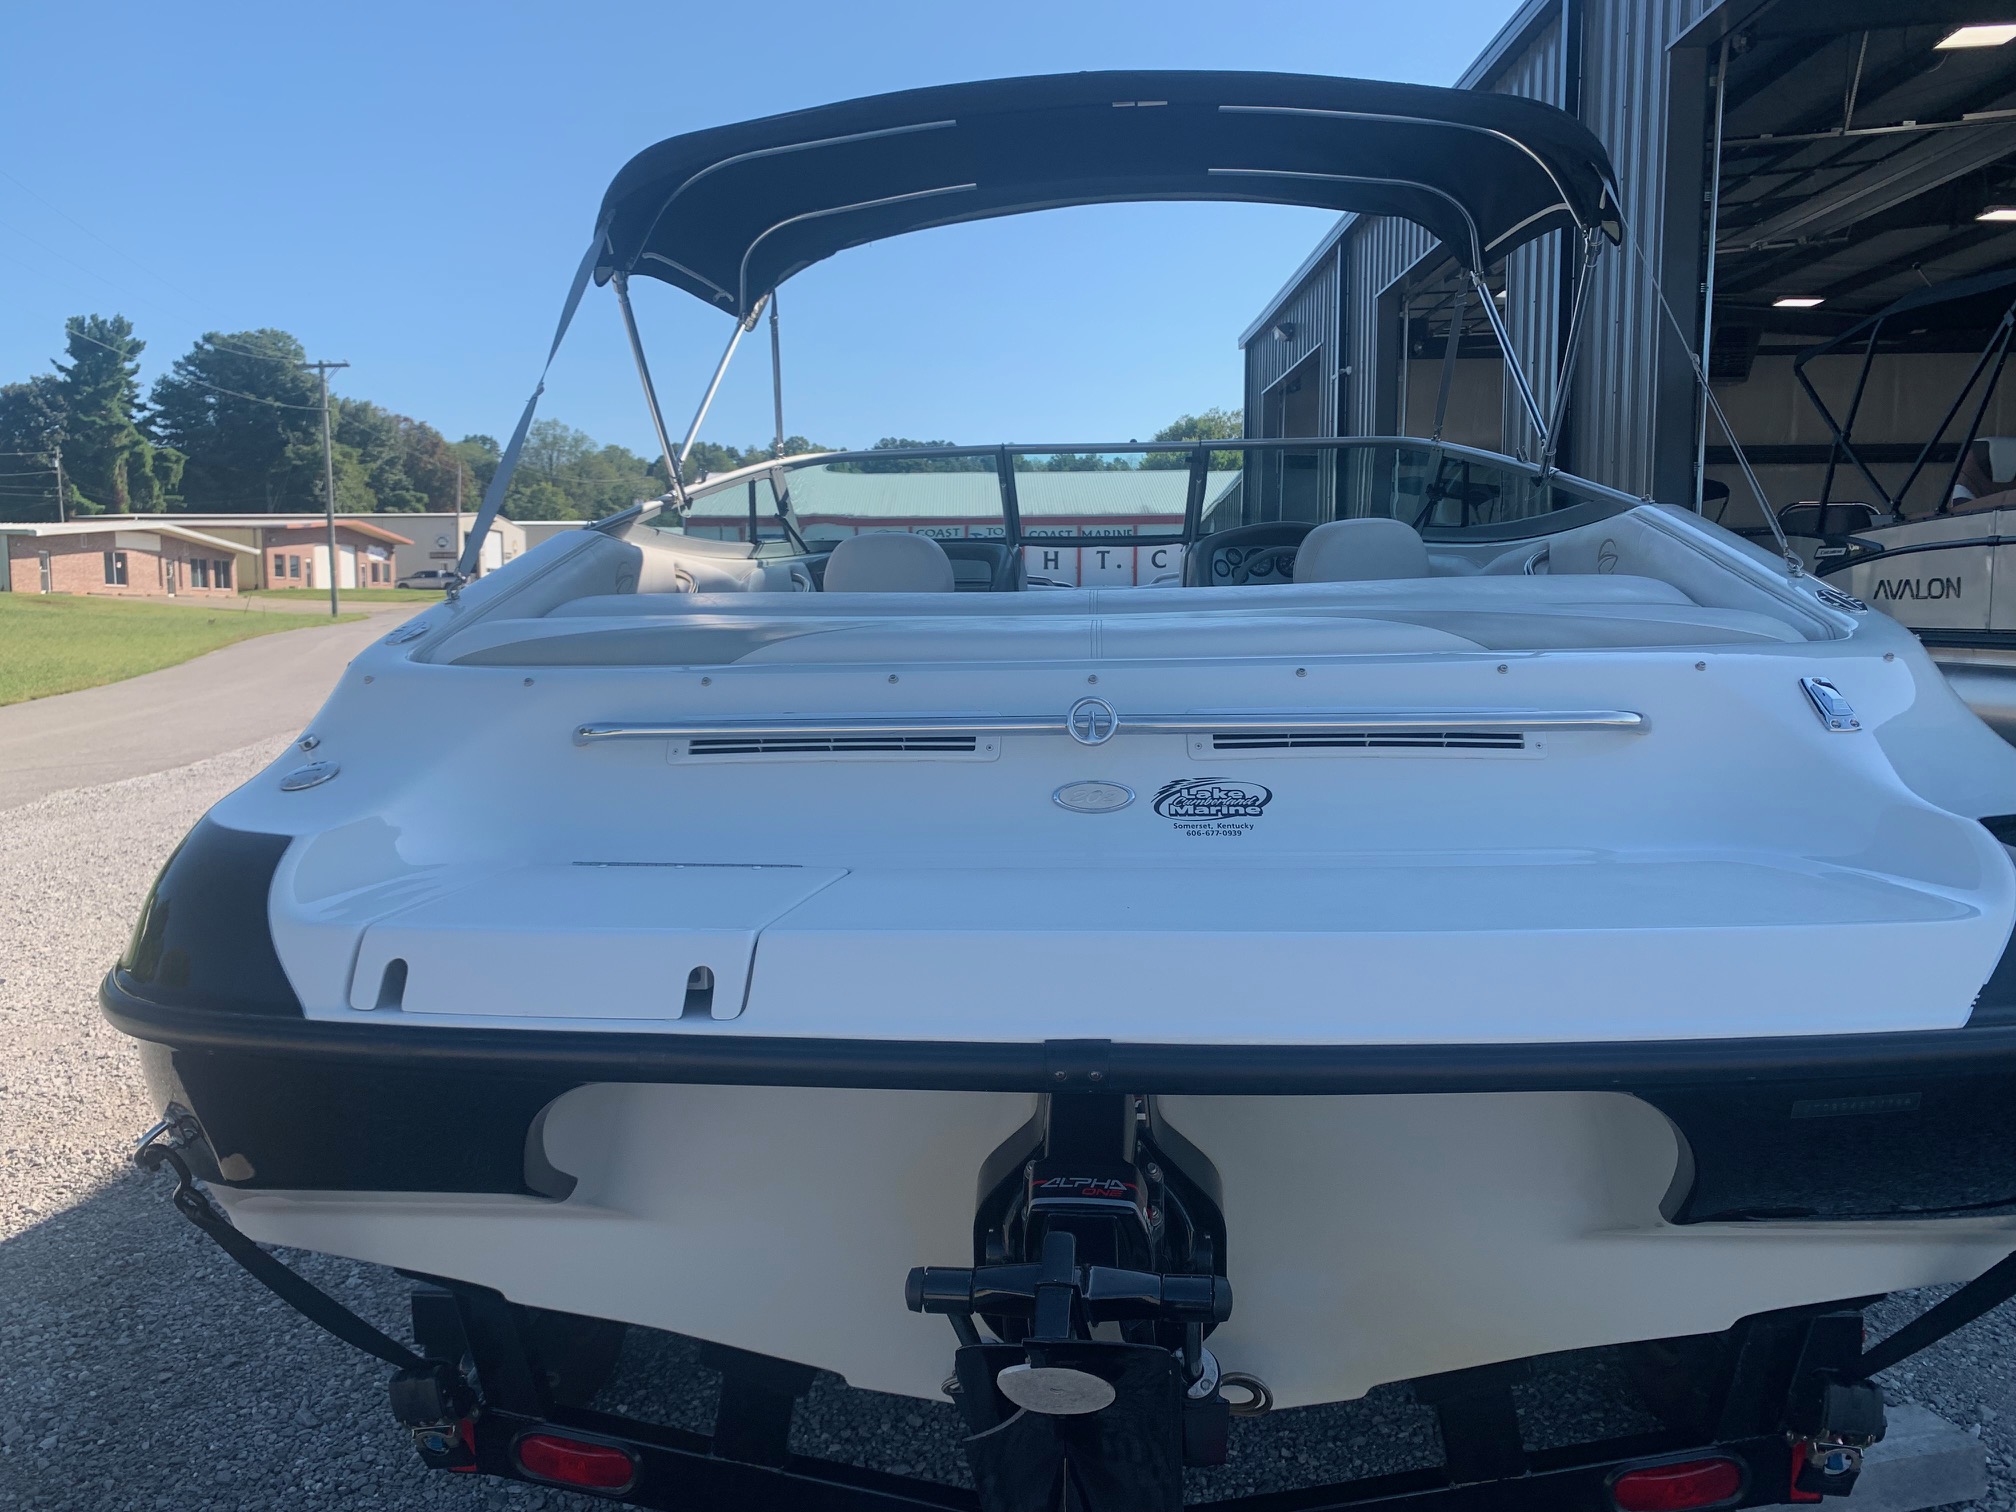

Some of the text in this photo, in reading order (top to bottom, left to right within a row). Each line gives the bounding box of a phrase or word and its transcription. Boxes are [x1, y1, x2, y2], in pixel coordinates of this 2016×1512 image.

[916, 527, 961, 538] COAST
[986, 527, 1004, 537] TO
[1043, 550, 1060, 570] H
[1151, 549, 1168, 569] C
[1872, 576, 1962, 600] AVALON
[1180, 787, 1246, 799] Lake
[1173, 796, 1259, 806] Cumberland
[1169, 804, 1263, 816] Marine
[1173, 822, 1255, 831] Somerset, Kentucky
[1040, 1177, 1127, 1191] ALPHA
[1082, 1188, 1124, 1197] ONE
